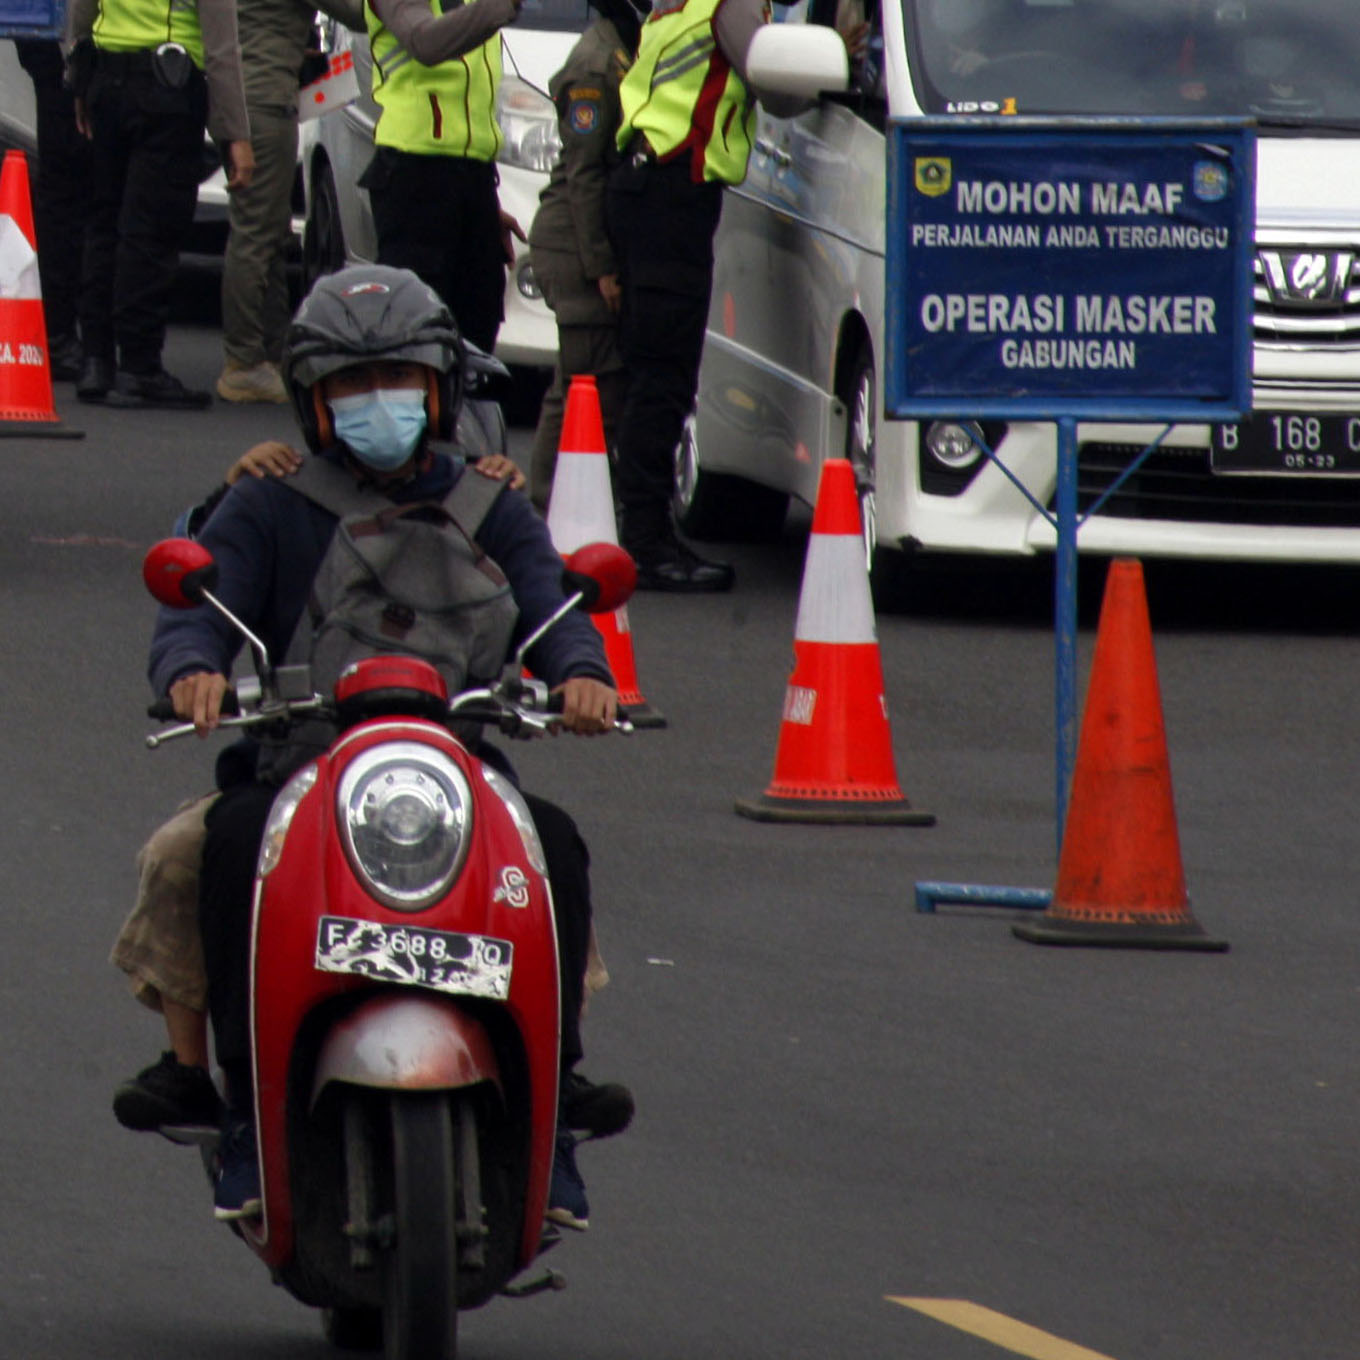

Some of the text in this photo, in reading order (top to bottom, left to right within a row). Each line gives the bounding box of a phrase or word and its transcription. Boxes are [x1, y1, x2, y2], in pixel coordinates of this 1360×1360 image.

[957, 181, 1183, 215] MOHON MAAF
[912, 224, 1229, 249] PERJALANAN ANDA TERGANGGU
[921, 294, 1217, 334] OPERASI MASKER
[1001, 339, 1136, 369] GABUNGAN
[1272, 415, 1321, 451] 168
